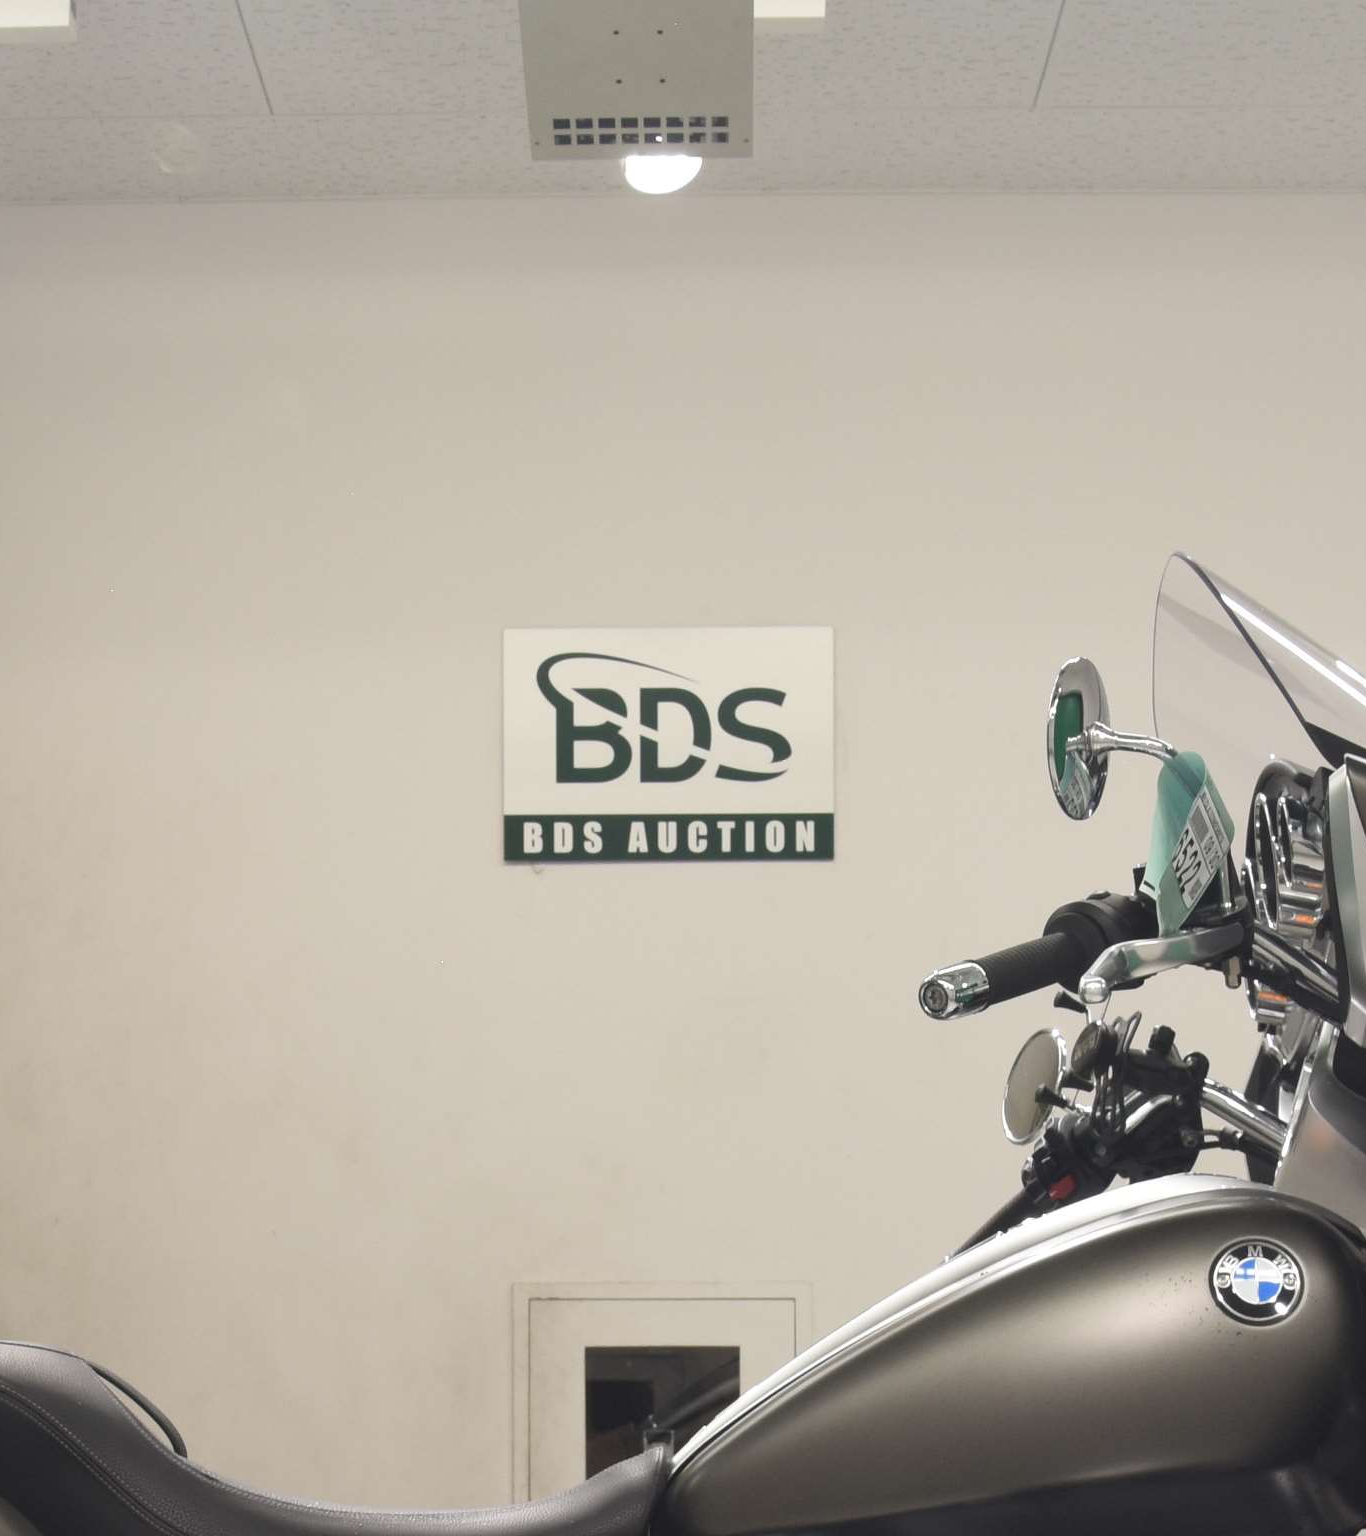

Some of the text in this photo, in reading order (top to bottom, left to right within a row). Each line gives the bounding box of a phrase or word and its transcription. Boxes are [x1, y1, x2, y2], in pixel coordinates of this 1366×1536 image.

[536, 652, 792, 783] BDS
[523, 820, 816, 854] BDS AUCTION
